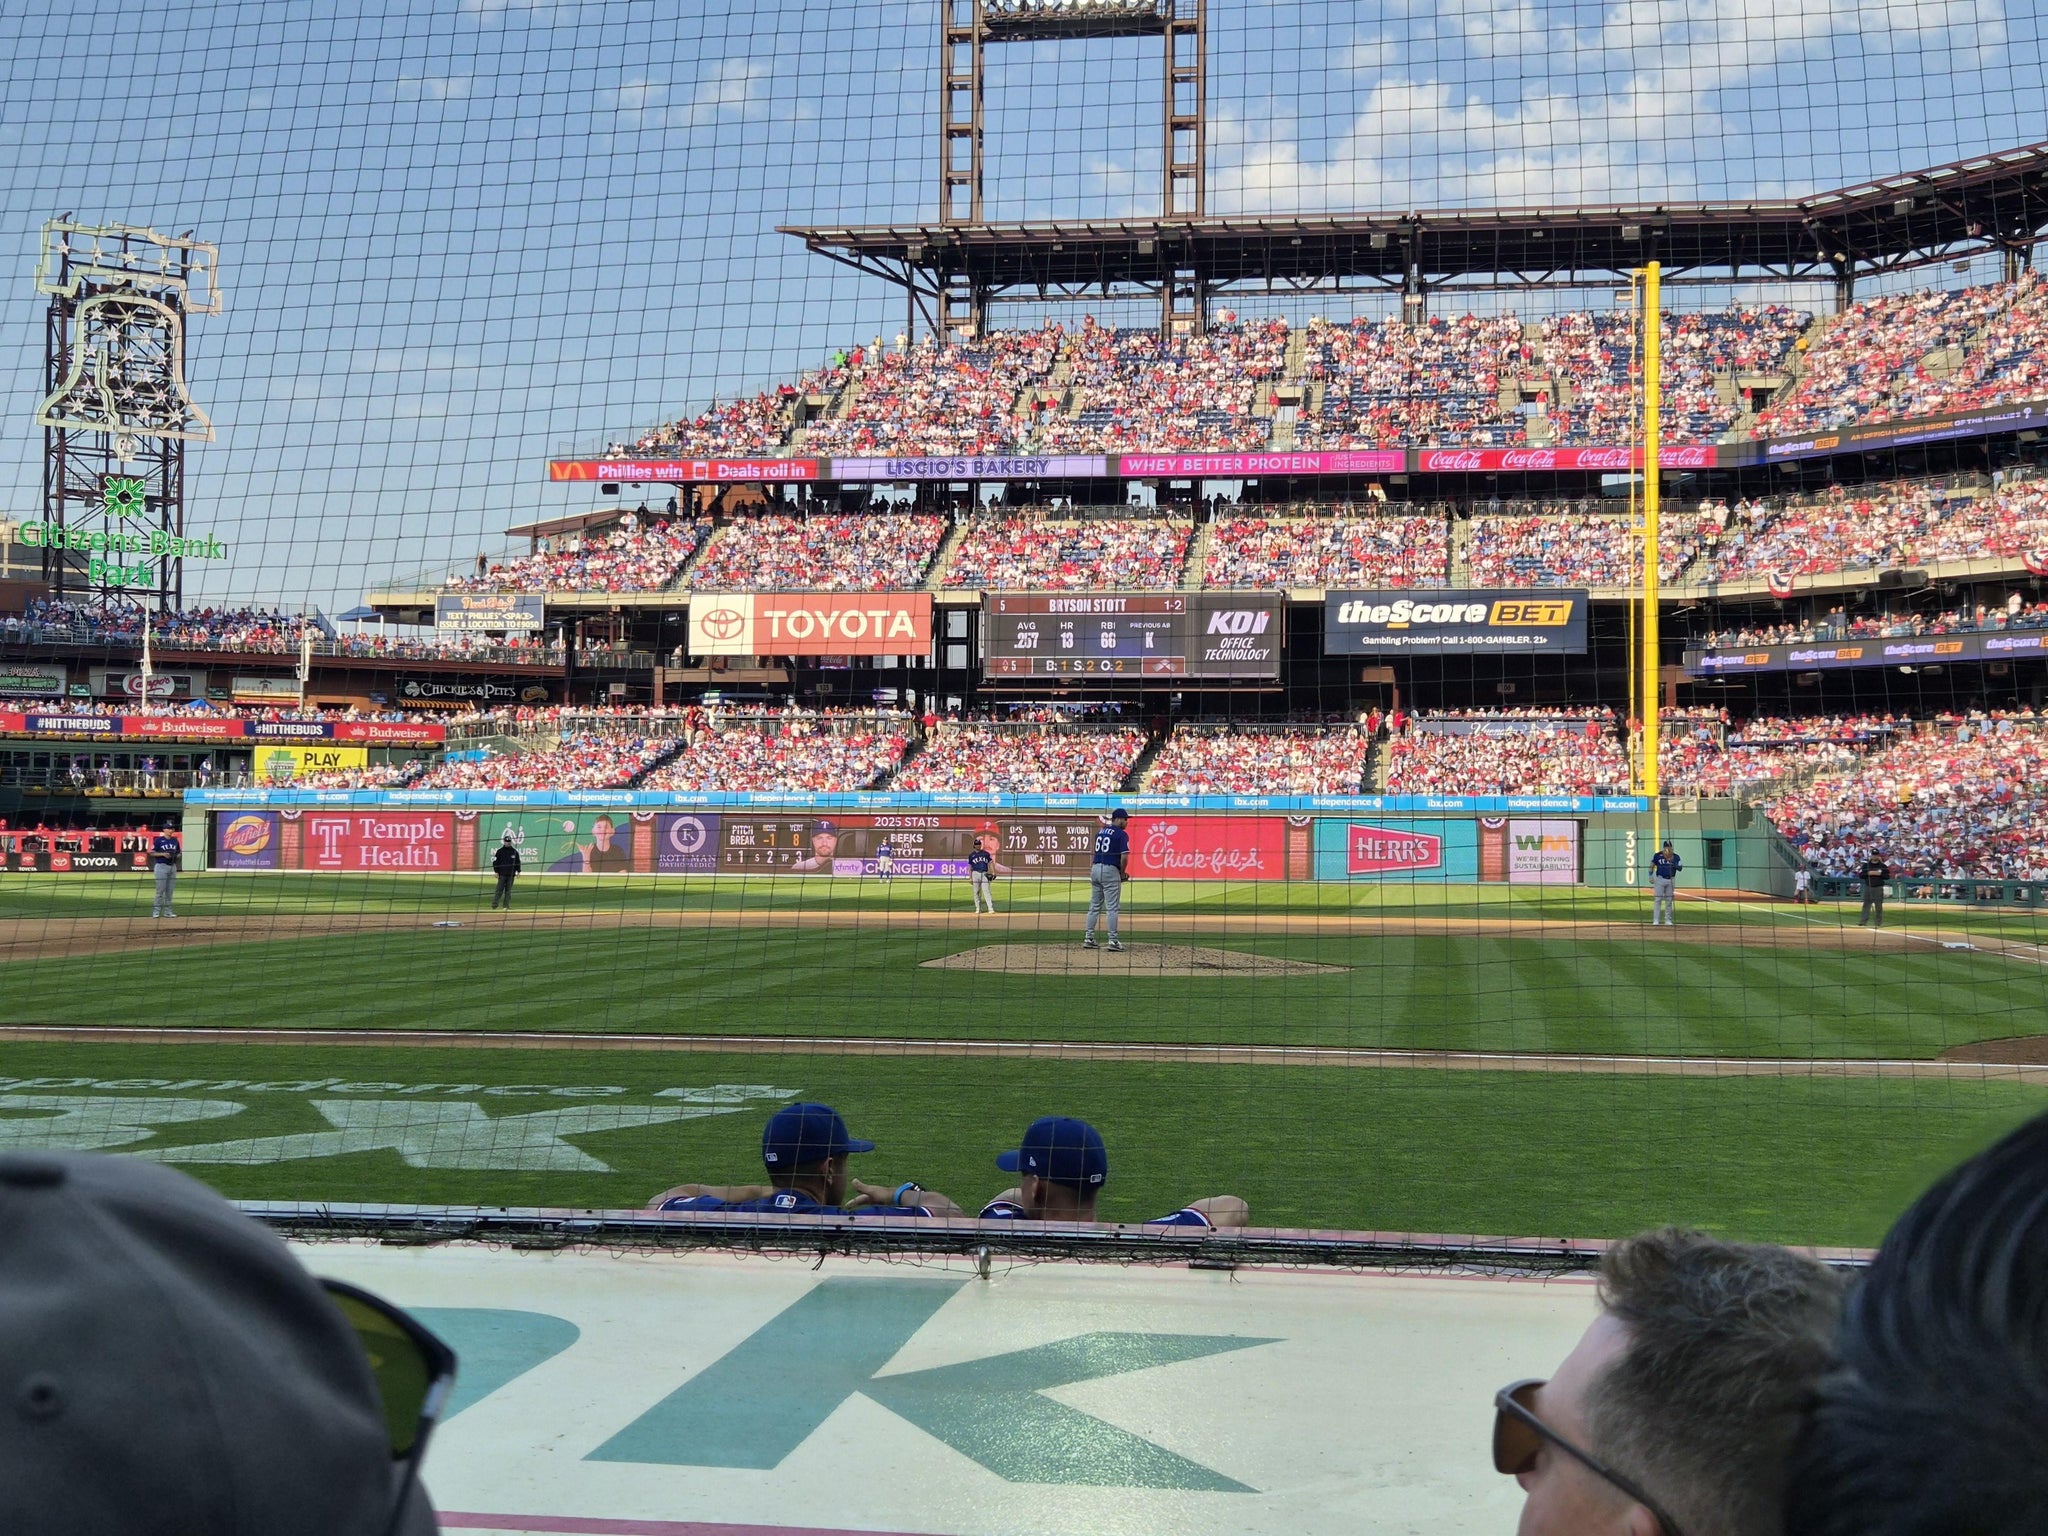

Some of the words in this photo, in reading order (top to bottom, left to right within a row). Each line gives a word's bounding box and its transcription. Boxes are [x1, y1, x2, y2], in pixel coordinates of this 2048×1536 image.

[1815, 437, 1838, 450] BET
[1128, 459, 1178, 473] WHEY
[1183, 458, 1243, 472] BETTER
[1250, 456, 1321, 470] PROTEIN
[1333, 460, 1392, 469] INGREDIENTS
[1428, 451, 1485, 470] Coca-Cola
[1501, 450, 1558, 469] Coca-Cola
[1576, 449, 1633, 468] Coca-Cola
[598, 464, 652, 479] Phillies
[655, 464, 683, 478] win
[718, 464, 761, 479] Deals
[763, 463, 788, 477] roll
[790, 463, 805, 477] in
[886, 459, 967, 478] LISCIO'S
[972, 458, 1050, 477] BAKERY
[18, 520, 143, 552] Citizens
[150, 530, 224, 560] Bank
[88, 558, 155, 588] Park
[1000, 600, 1006, 611] 5
[1049, 598, 1091, 612] BRYSON
[1093, 598, 1127, 612] STOTT
[1164, 600, 1182, 611] 1-2
[1337, 599, 1488, 625] theScore
[1496, 604, 1565, 622] BET
[763, 609, 917, 639] TOYOTA
[1017, 622, 1036, 630] AVG
[1060, 622, 1074, 630] HR
[1100, 622, 1116, 630] RBI
[1206, 611, 1270, 634] KDI
[1145, 632, 1155, 649] K
[1219, 637, 1255, 649] OFFICE
[1362, 635, 1401, 646] Gambling
[1402, 635, 1441, 645] Problem?
[1442, 635, 1458, 645] Call
[1204, 648, 1270, 661] TECHNOLOGY
[1790, 649, 1836, 662] theScore
[1837, 648, 1861, 659] BET
[1884, 642, 1935, 656] theScore
[1936, 642, 1961, 653] BET
[1011, 660, 1017, 671] 5
[1061, 660, 1068, 671] 1
[1086, 660, 1095, 671] 2
[1115, 660, 1124, 671] 2
[1701, 654, 1745, 667] theScore
[1745, 653, 1768, 664] BET
[420, 683, 476, 697] CHICKIE'S
[484, 684, 516, 699] PETE'S
[37, 717, 111, 730] #HITTHEBUDS
[254, 724, 324, 737] #HITTHEBUDS
[304, 752, 341, 767] PLAY
[389, 792, 444, 802] Independence
[495, 794, 527, 802] ibx.com
[568, 793, 623, 803] Independence
[674, 794, 708, 803] ibx.com
[858, 795, 892, 803] ibx.com
[1121, 796, 1179, 806] Independence
[1233, 797, 1269, 807] ibx.com
[1312, 797, 1372, 808] Independence
[1427, 799, 1463, 808] ibx.com
[1508, 798, 1569, 809] Independence
[874, 817, 902, 827] 2025
[904, 817, 940, 827] STATS
[223, 820, 271, 849] Hatfield
[359, 818, 445, 844] Temple
[732, 825, 754, 835] PITCH
[730, 835, 755, 846] BREAK
[763, 833, 775, 846] -1
[793, 833, 800, 846] 8
[890, 833, 924, 843] BEEKS
[1005, 835, 1028, 849] .719
[1036, 836, 1058, 849] .315
[1067, 836, 1089, 850] .319
[1095, 836, 1111, 853] 68
[490, 848, 538, 856] NURS
[1143, 829, 1265, 874] Chick-fil-A
[1355, 836, 1430, 862] HERR'S
[73, 857, 118, 866] TOYOTA
[359, 845, 440, 867] Health
[659, 854, 717, 862] ROTHMAN
[738, 850, 744, 864] 1
[755, 854, 760, 862] S
[766, 851, 774, 864] 2
[796, 850, 802, 863] 3
[1025, 854, 1043, 865] WRC+
[1050, 854, 1066, 865] 100
[1626, 831, 1635, 884] 330
[833, 863, 860, 873] xfinity
[941, 864, 956, 874] 88
